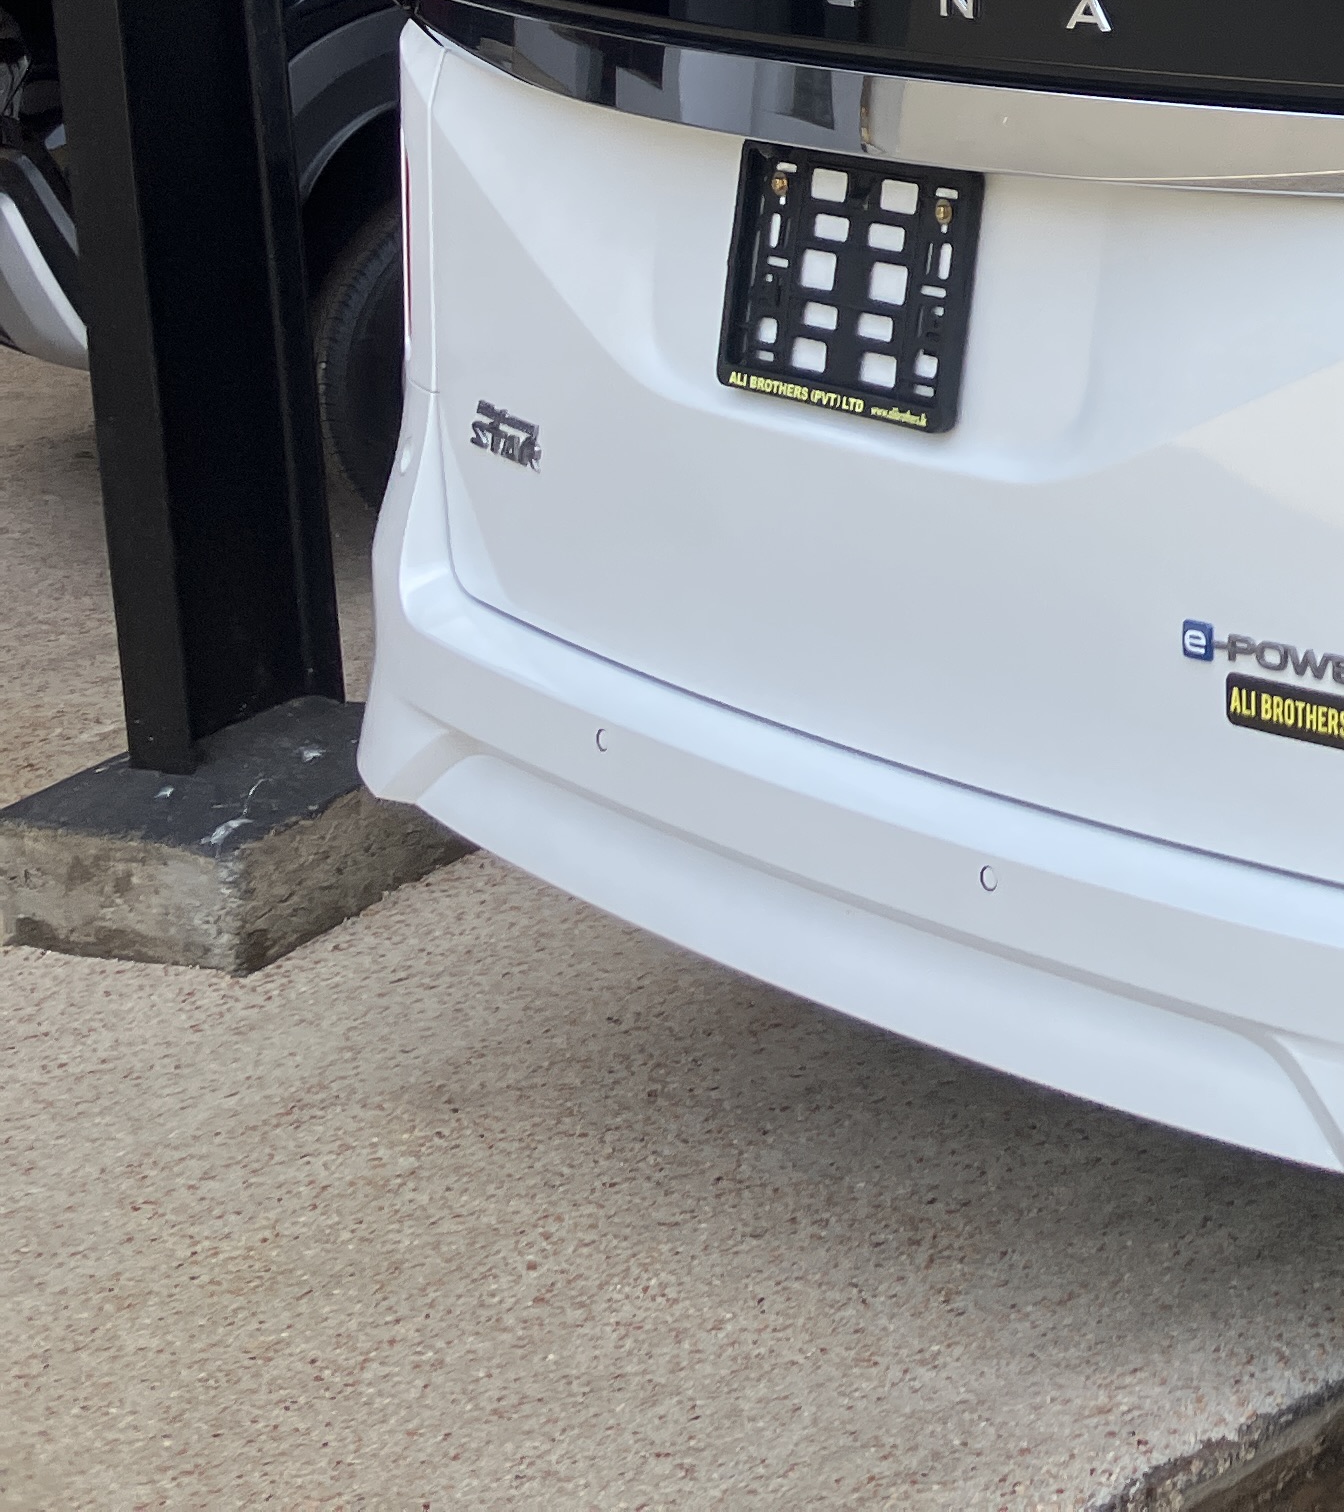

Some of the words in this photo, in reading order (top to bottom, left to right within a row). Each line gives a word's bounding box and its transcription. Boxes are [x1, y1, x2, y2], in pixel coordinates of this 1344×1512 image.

[728, 371, 748, 387] ALI
[750, 375, 809, 401] BROTHERS
[810, 390, 840, 408] (PVT)
[842, 395, 864, 413] LTD
[1230, 686, 1256, 718] ALI
